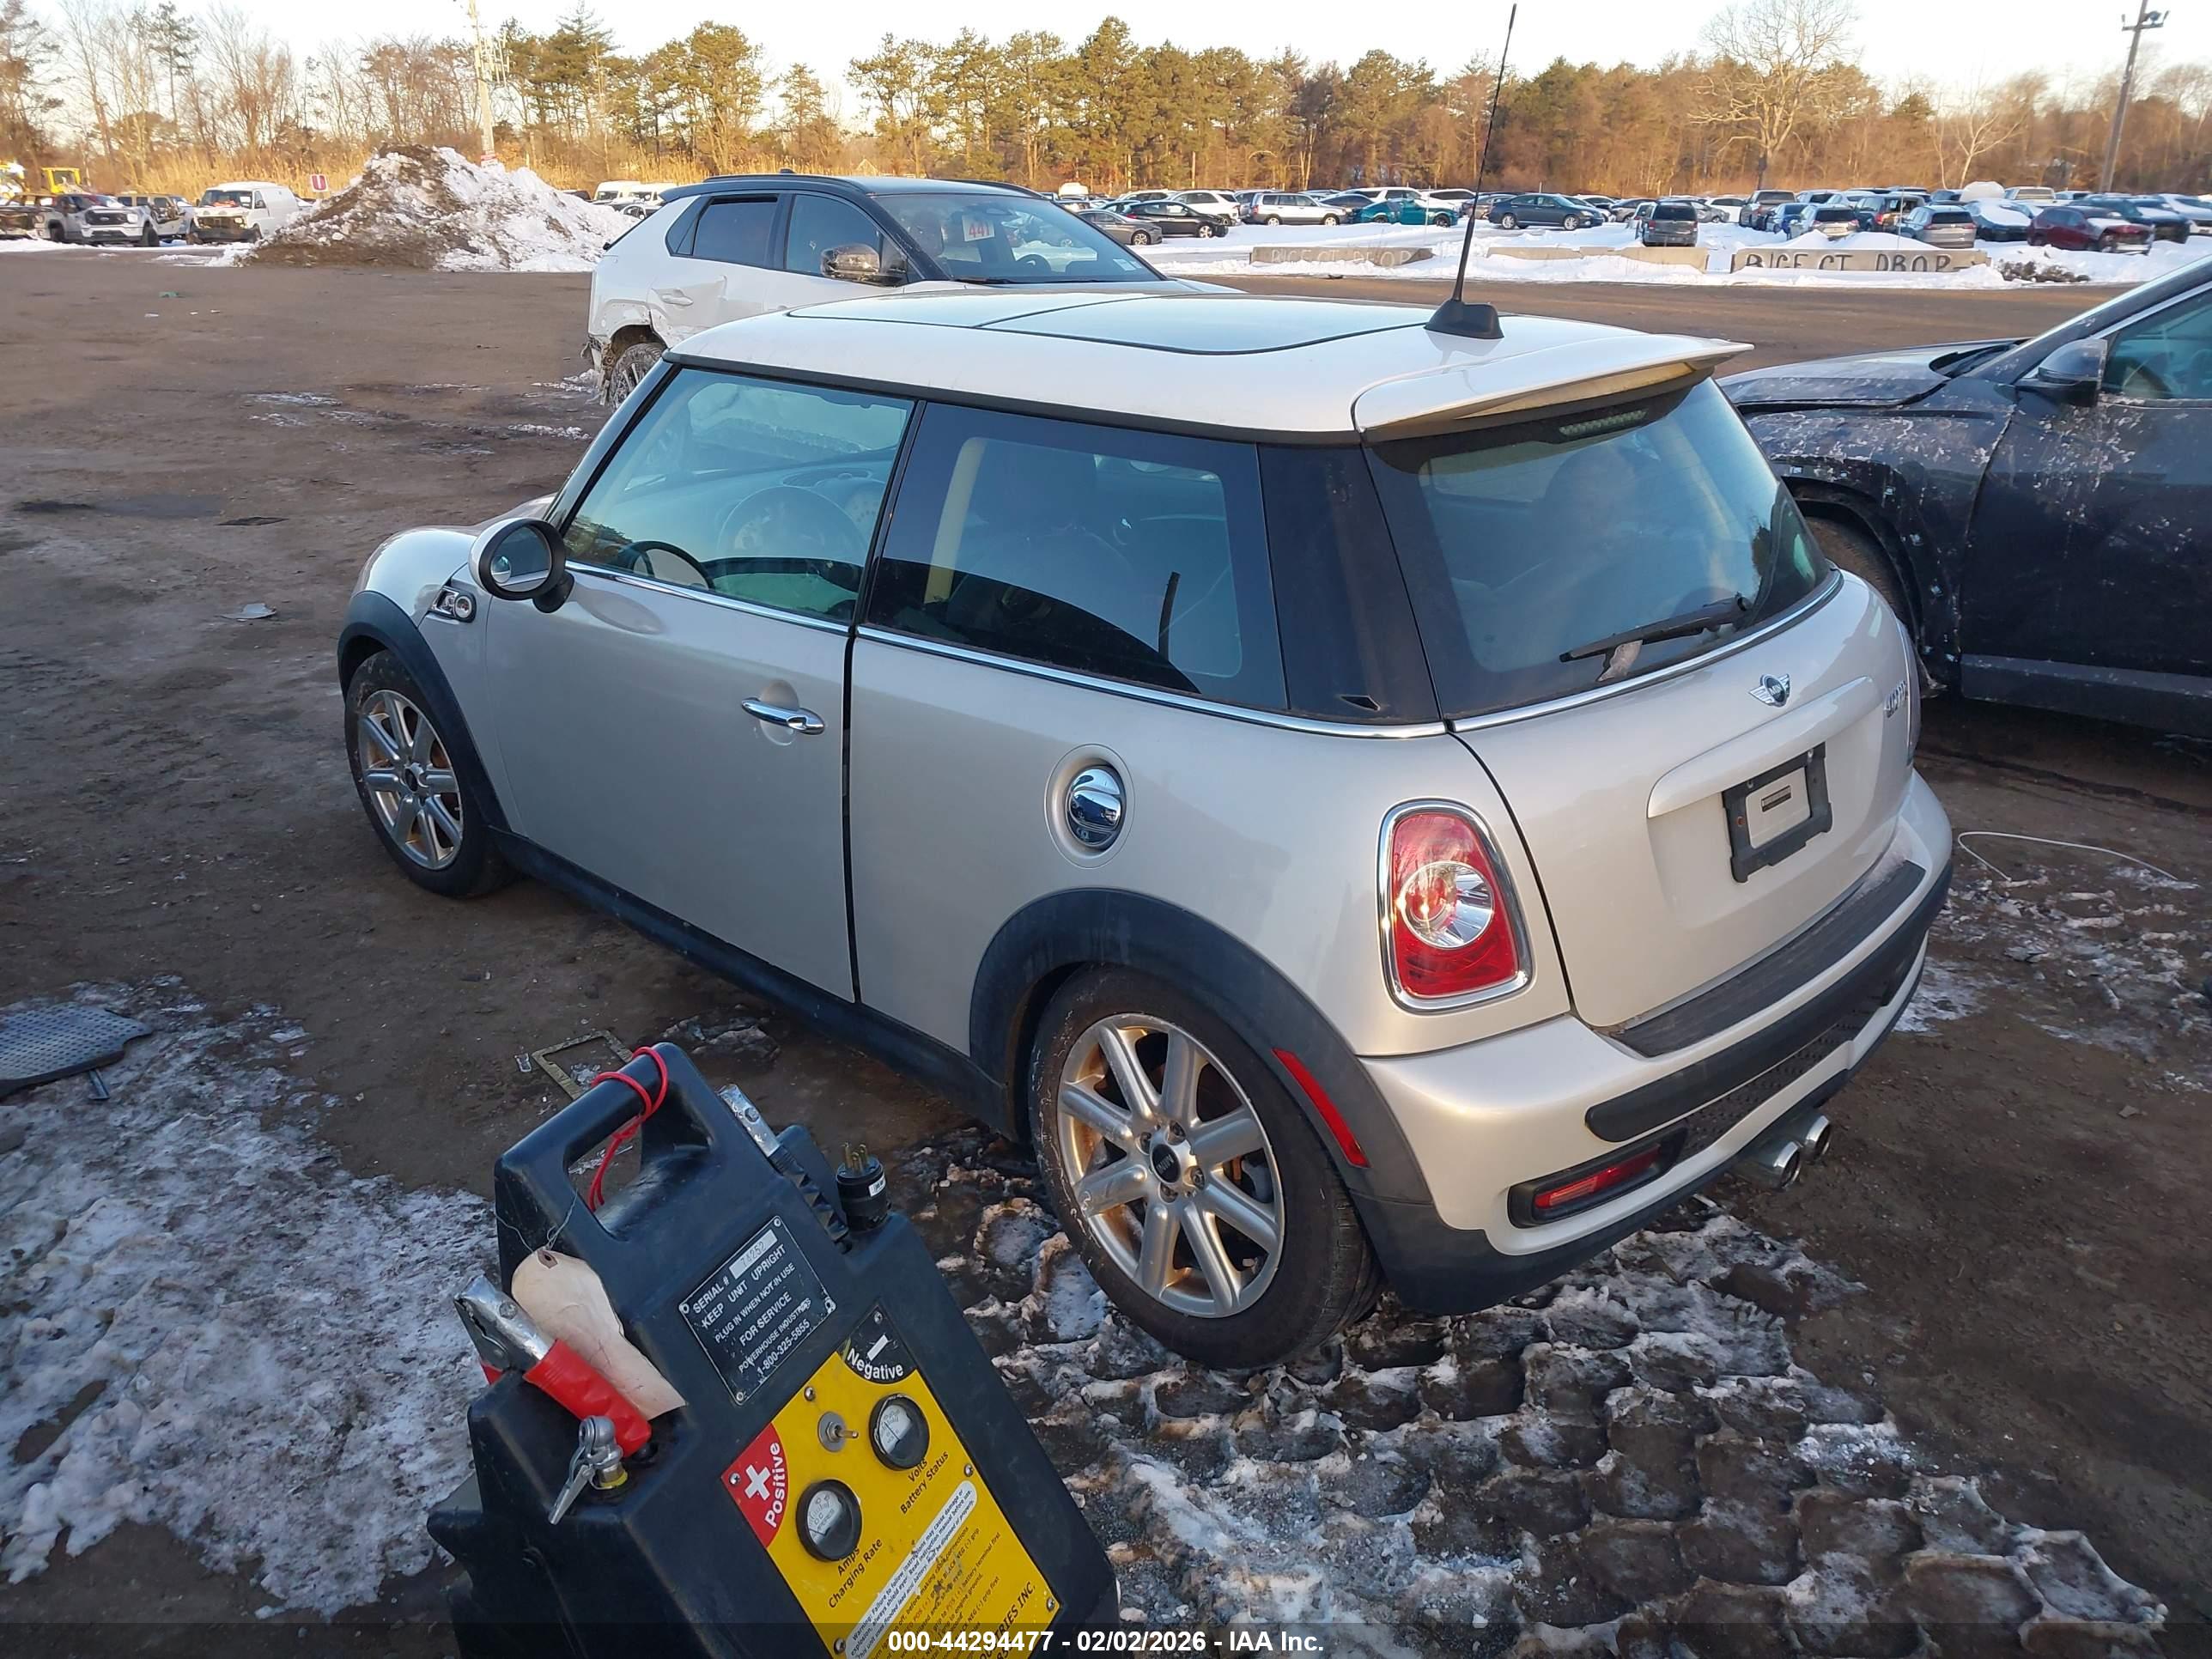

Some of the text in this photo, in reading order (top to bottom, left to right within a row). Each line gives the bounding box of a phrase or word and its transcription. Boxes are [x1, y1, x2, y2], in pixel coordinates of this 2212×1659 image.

[693, 1282, 724, 1314] SERIAL
[722, 1277, 730, 1285] #
[702, 1244, 787, 1328] KEEP UNIT UPRIGHT
[715, 1263, 795, 1344] PLUG IN WHEN NOT IN USE
[740, 1292, 792, 1346] FOR SERVICE
[739, 1330, 780, 1373] POWERHOUSE
[757, 1319, 811, 1375] 1-800-325-5855
[847, 1348, 904, 1380] Negative
[765, 1442, 786, 1528] Positive
[900, 1452, 949, 1514] Battery Status
[908, 1459, 927, 1482] Volts
[827, 1538, 882, 1609] Charging Rate
[836, 1547, 860, 1576] Amps
